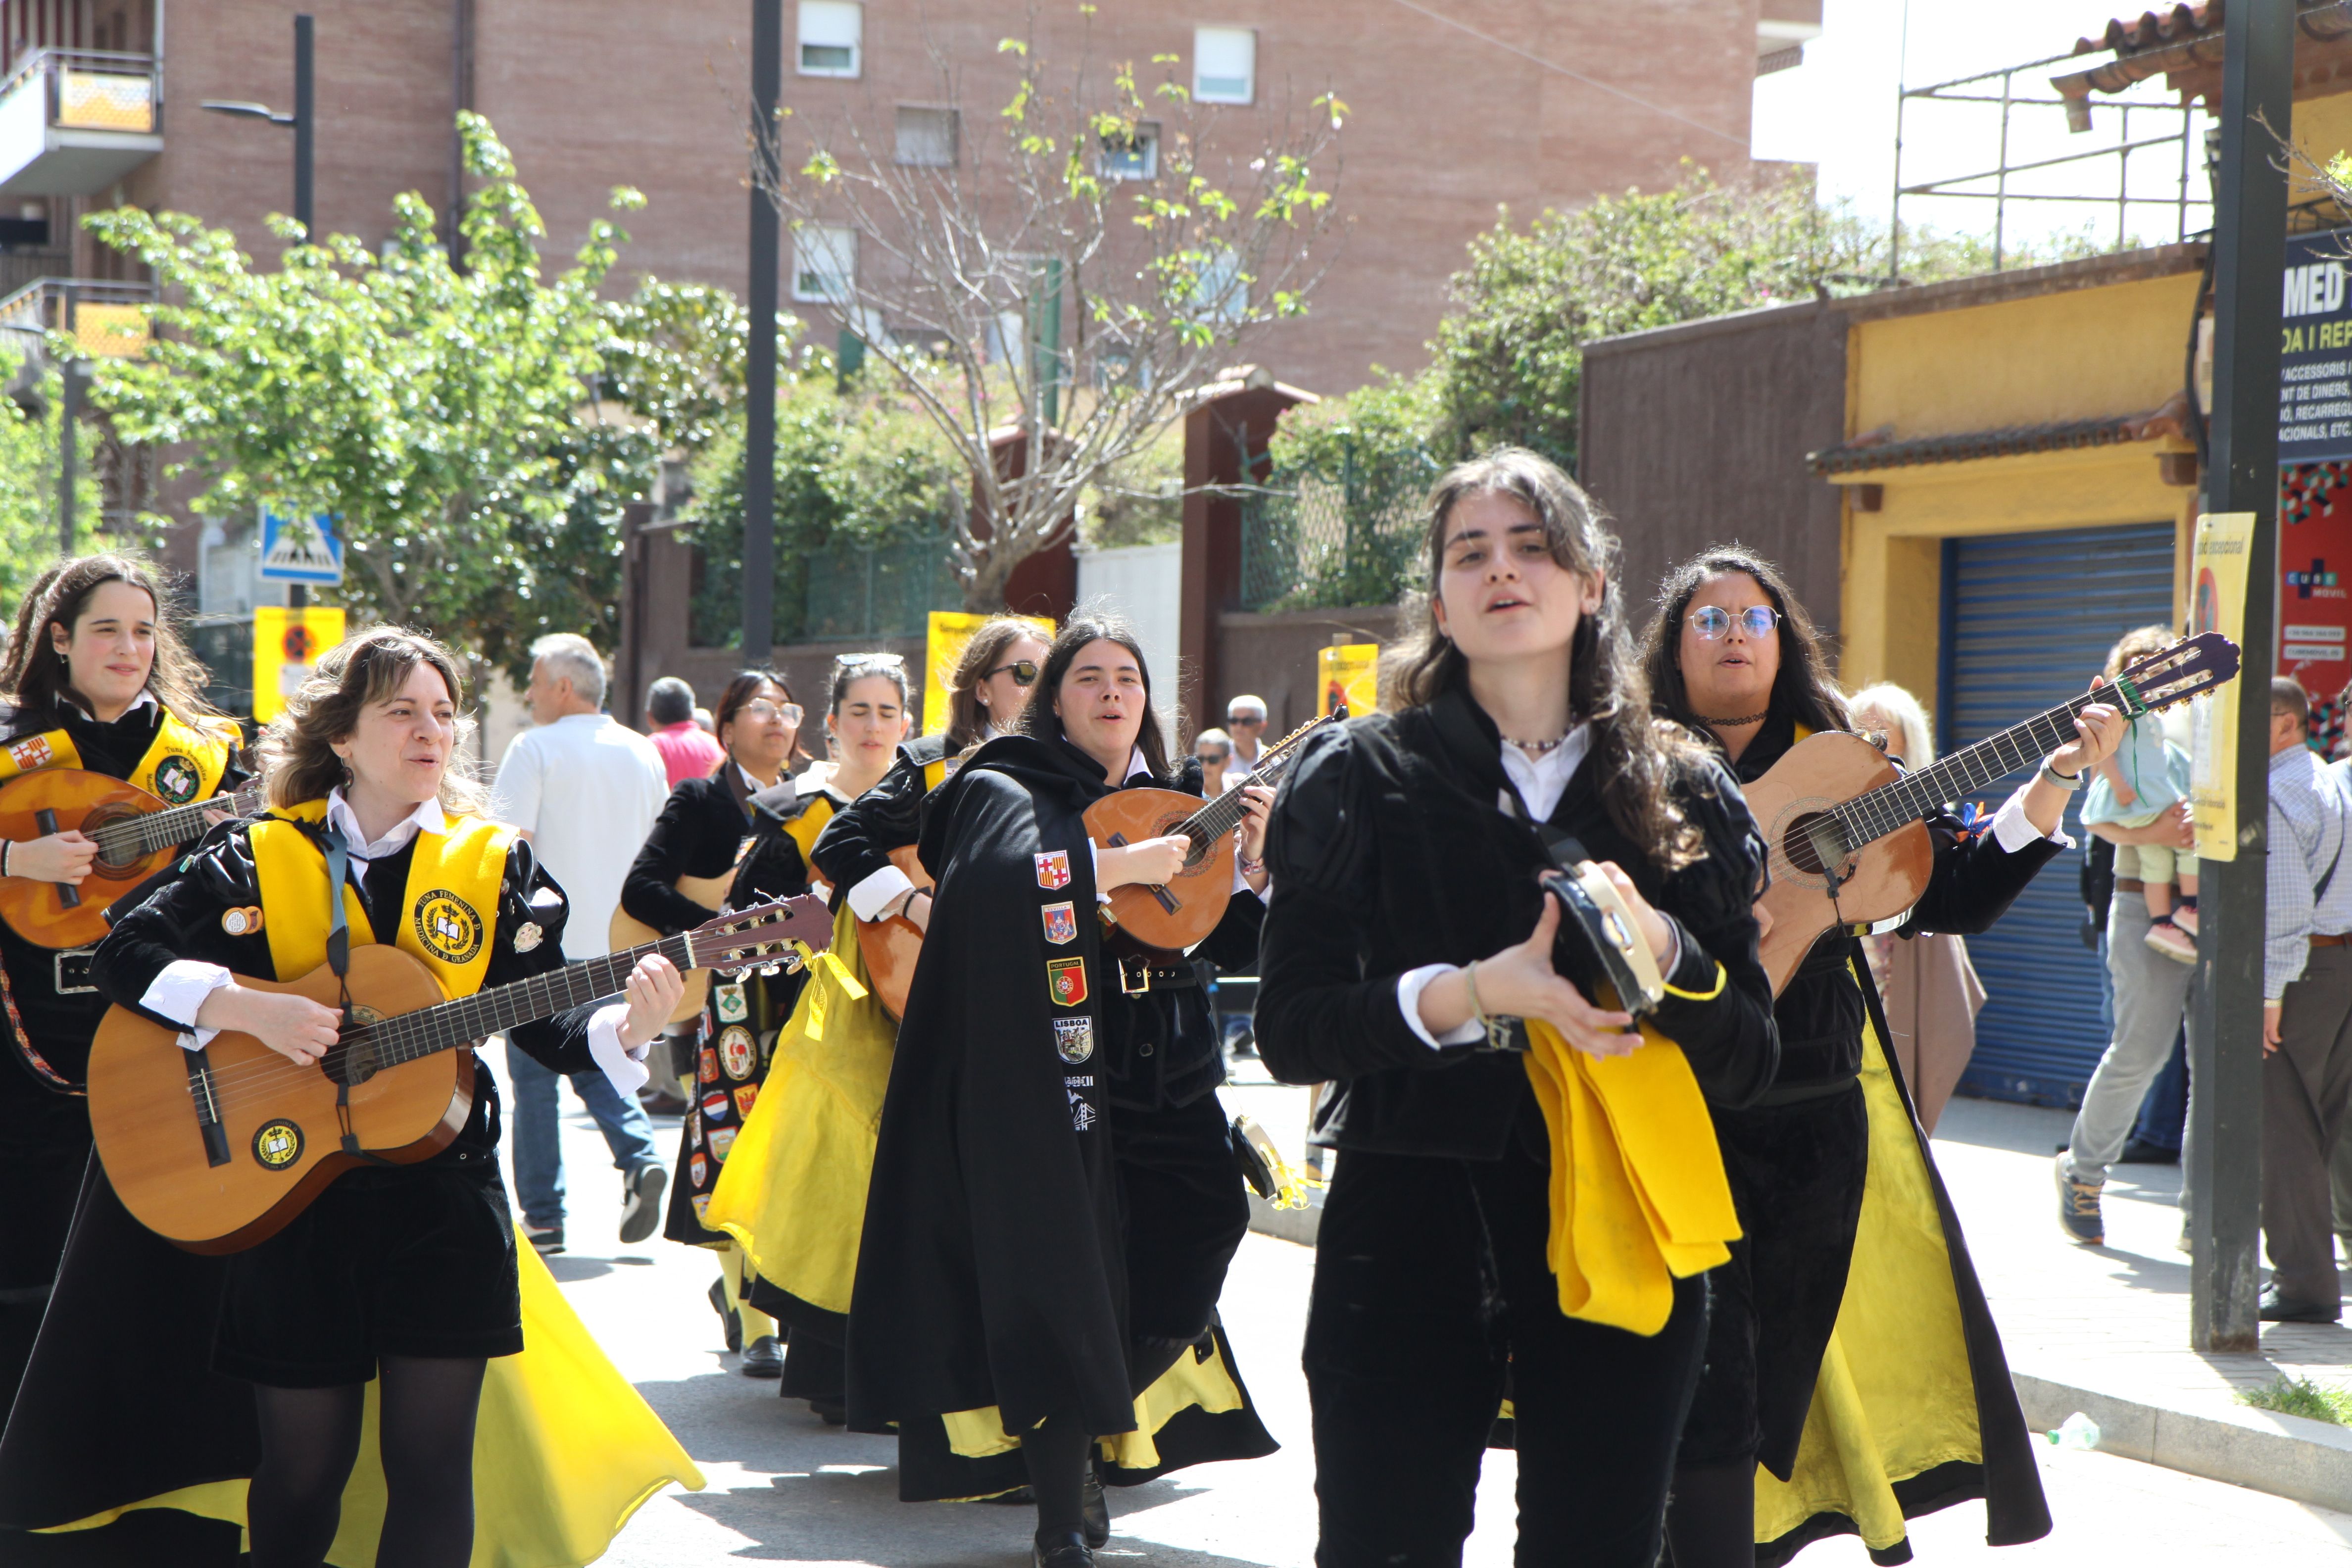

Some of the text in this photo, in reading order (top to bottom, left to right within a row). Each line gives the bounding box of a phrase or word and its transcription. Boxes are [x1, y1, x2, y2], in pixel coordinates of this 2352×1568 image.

[2283, 260, 2345, 318] MED
[2308, 324, 2315, 351] I
[2319, 319, 2352, 349] REP
[2296, 384, 2310, 401] DE
[2312, 588, 2347, 598] MOVIL
[418, 892, 438, 907] TUNA
[440, 891, 476, 921] FEMENINA
[415, 918, 439, 956] MEDICINA
[451, 944, 480, 963] GRANADA
[1055, 1019, 1087, 1028] LISBOA
